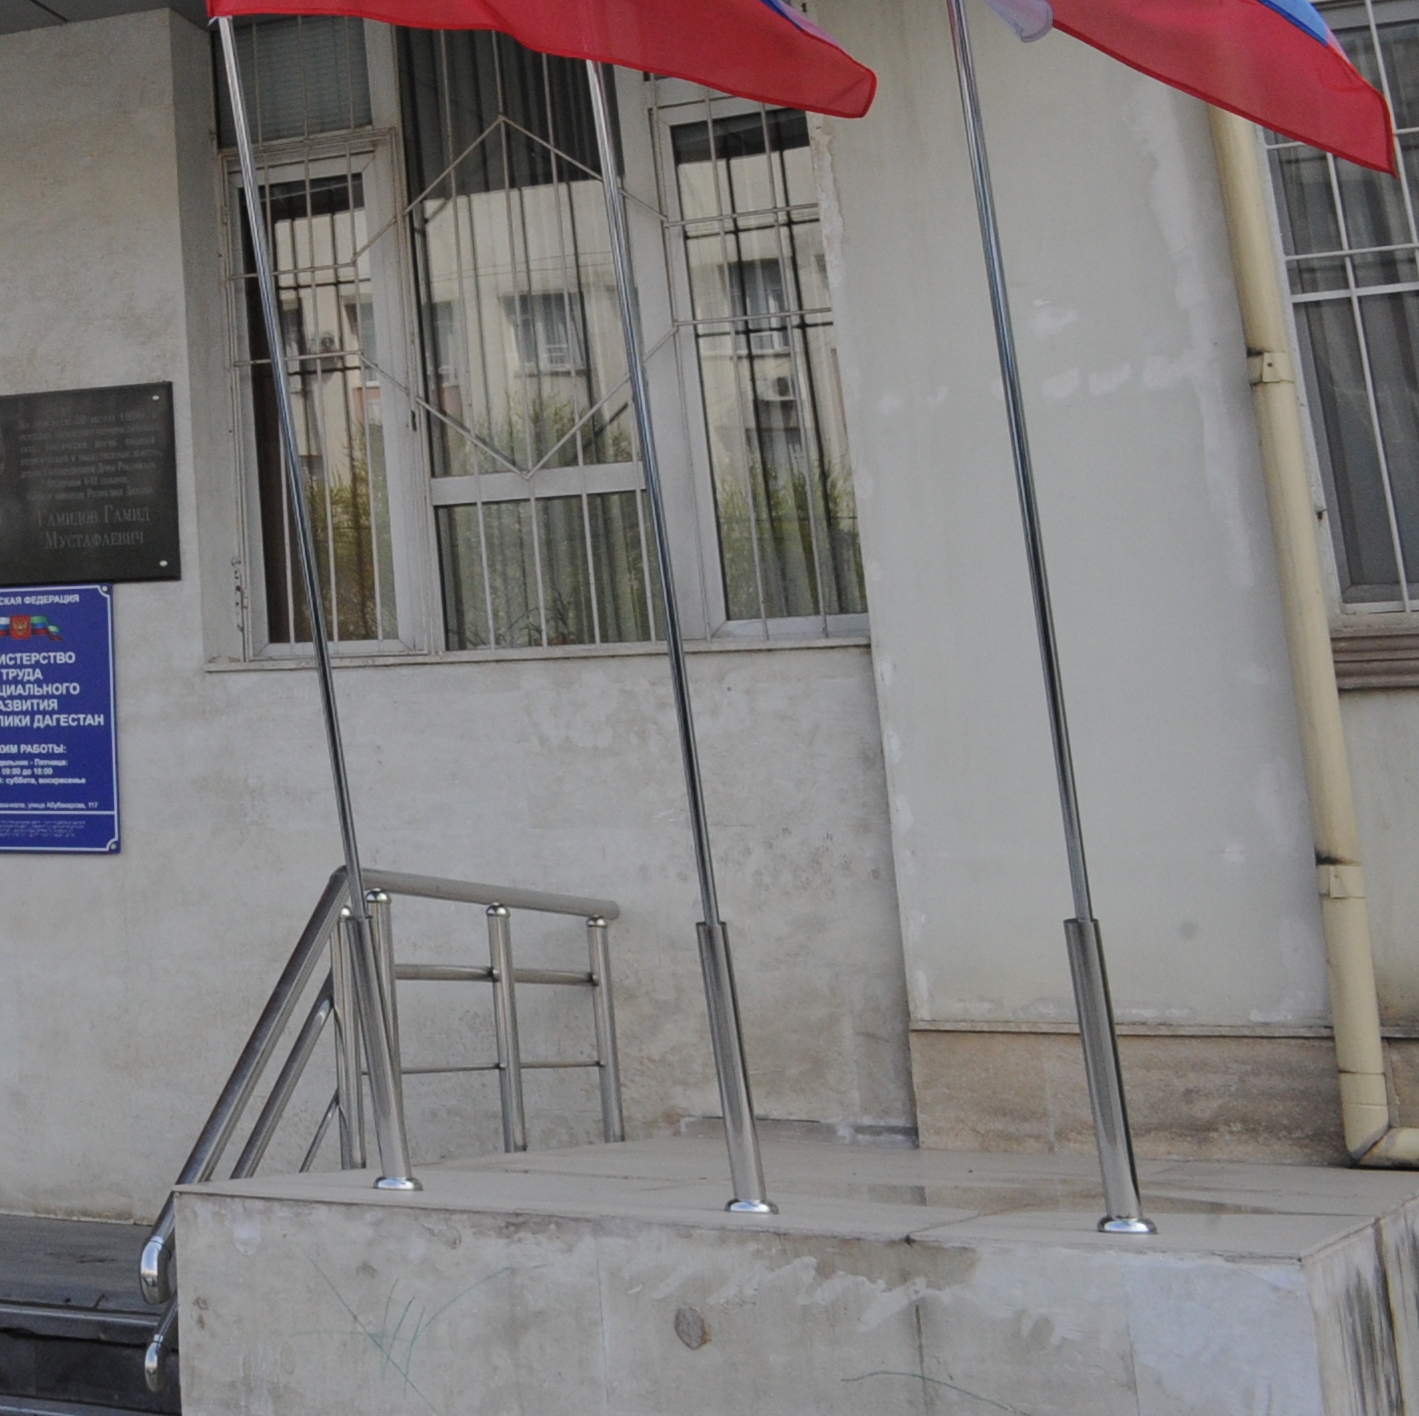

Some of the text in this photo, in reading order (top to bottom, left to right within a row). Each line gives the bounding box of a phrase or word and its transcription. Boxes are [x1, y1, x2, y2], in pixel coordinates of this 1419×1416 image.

[24, 594, 80, 606] ФЕДЕРАЦИЯ
[0, 668, 43, 682] ТРУДА
[33, 714, 104, 729] ДАГЕСТАН
[20, 744, 67, 754] РАБОТЫ:
